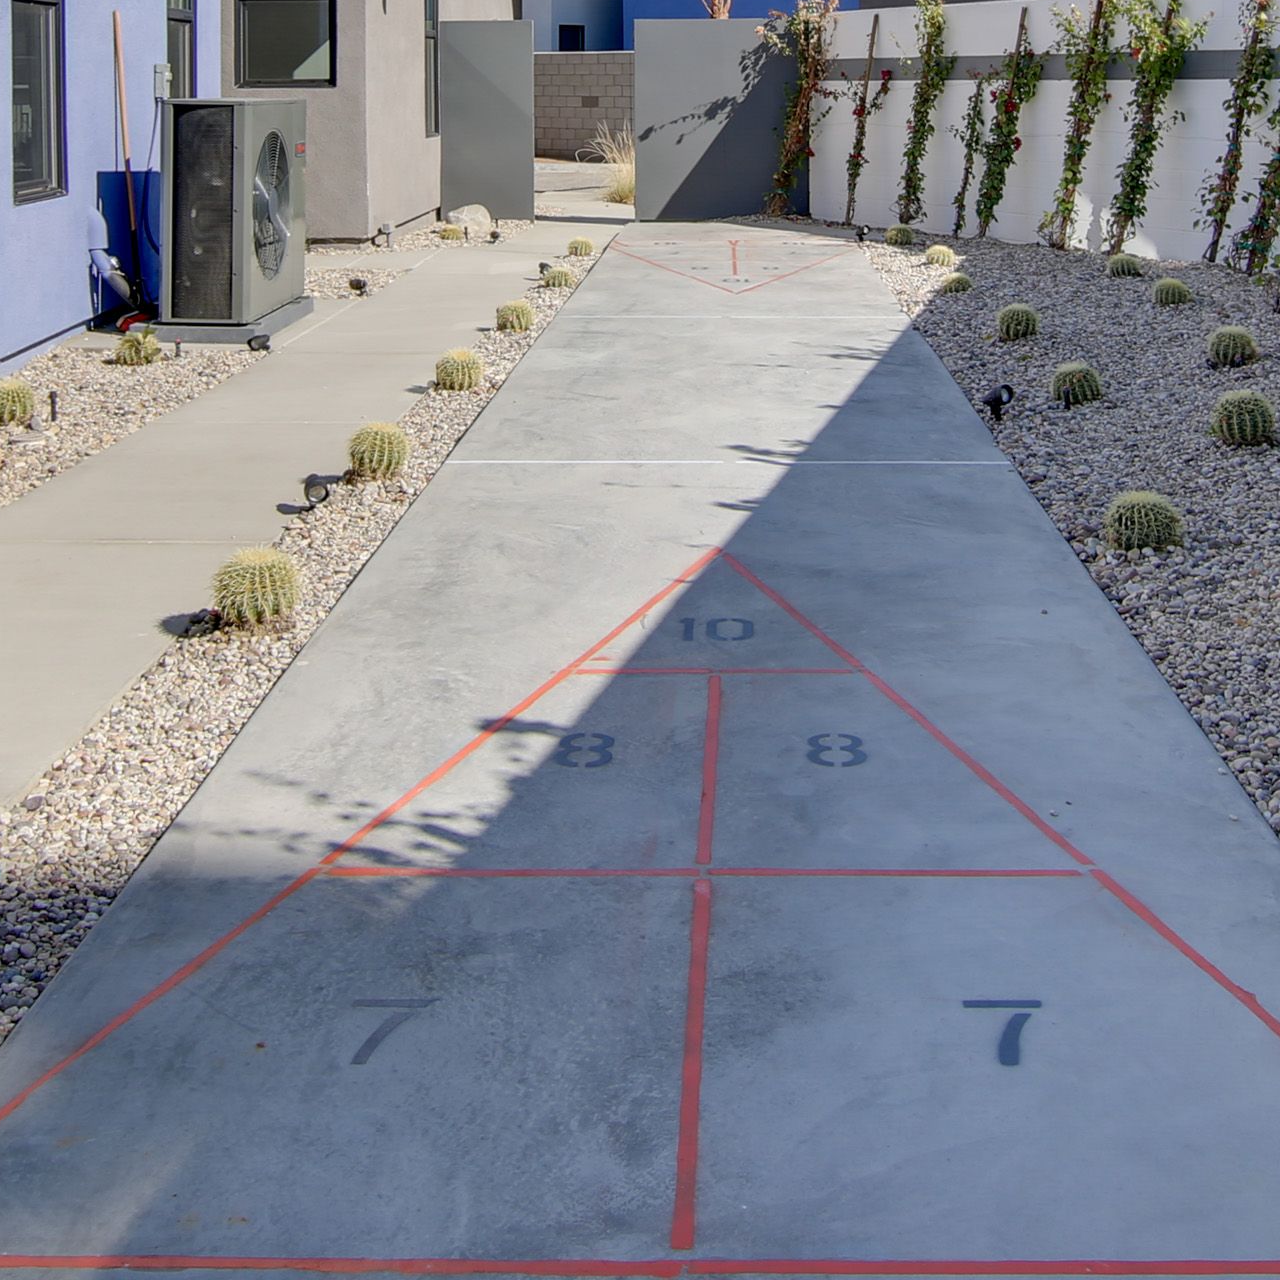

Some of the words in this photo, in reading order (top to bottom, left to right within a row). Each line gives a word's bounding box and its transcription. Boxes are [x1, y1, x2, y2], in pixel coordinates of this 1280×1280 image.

[680, 617, 754, 641] 10
[554, 732, 615, 768] 8
[806, 733, 868, 768] 8
[350, 998, 440, 1065] 7
[961, 999, 1043, 1068] 7
